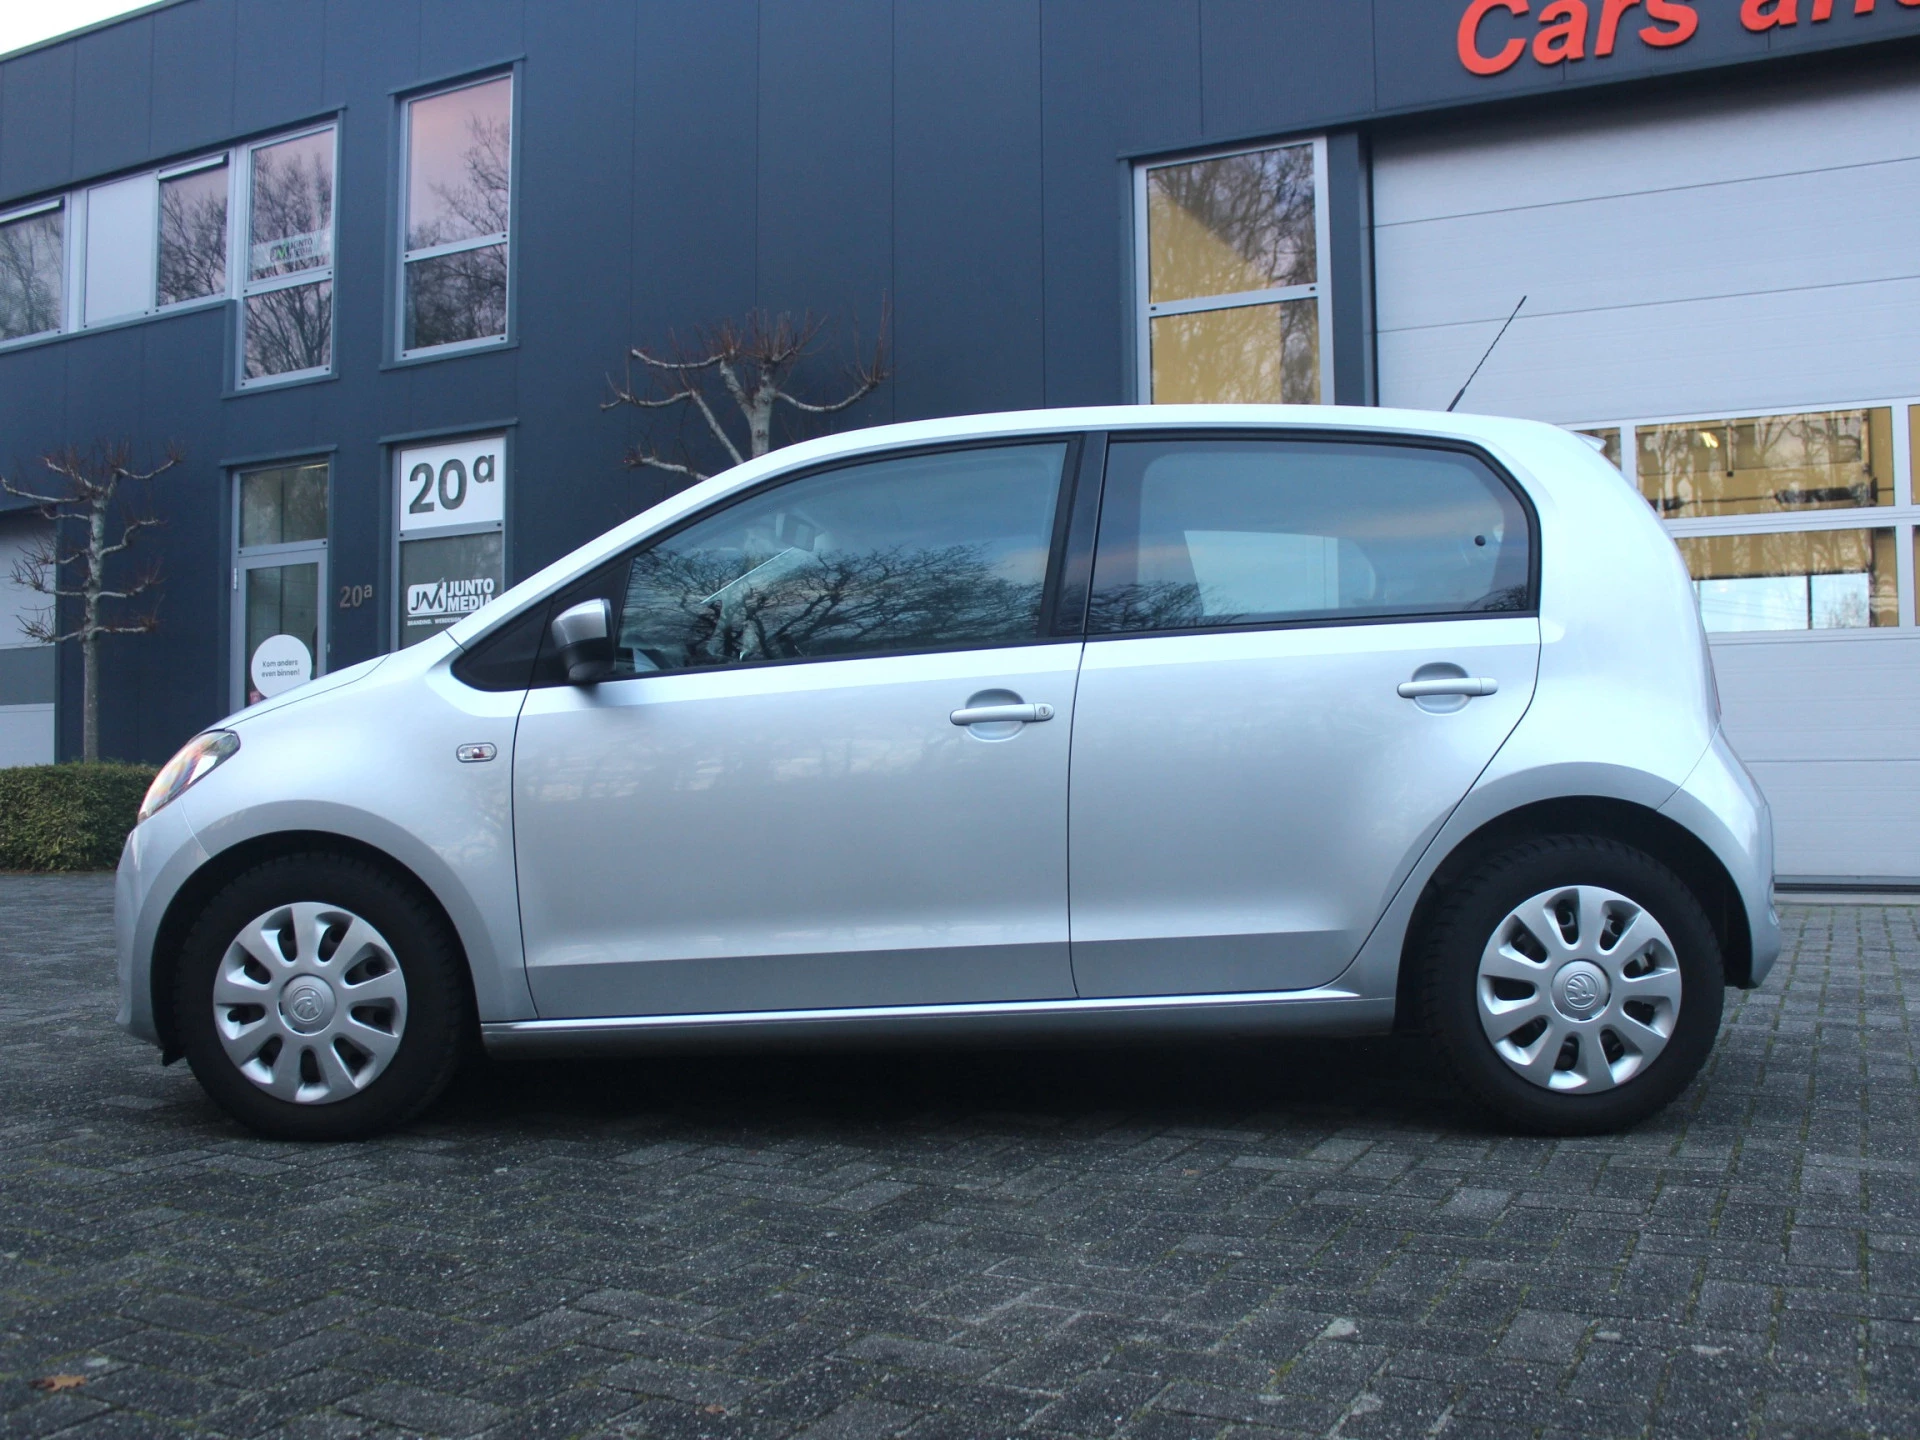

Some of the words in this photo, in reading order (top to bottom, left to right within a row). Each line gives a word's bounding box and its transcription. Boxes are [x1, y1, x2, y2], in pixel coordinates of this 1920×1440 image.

[1457, 0, 1698, 75] Cars
[447, 577, 495, 597] JUNTO
[262, 660, 277, 668] Kom
